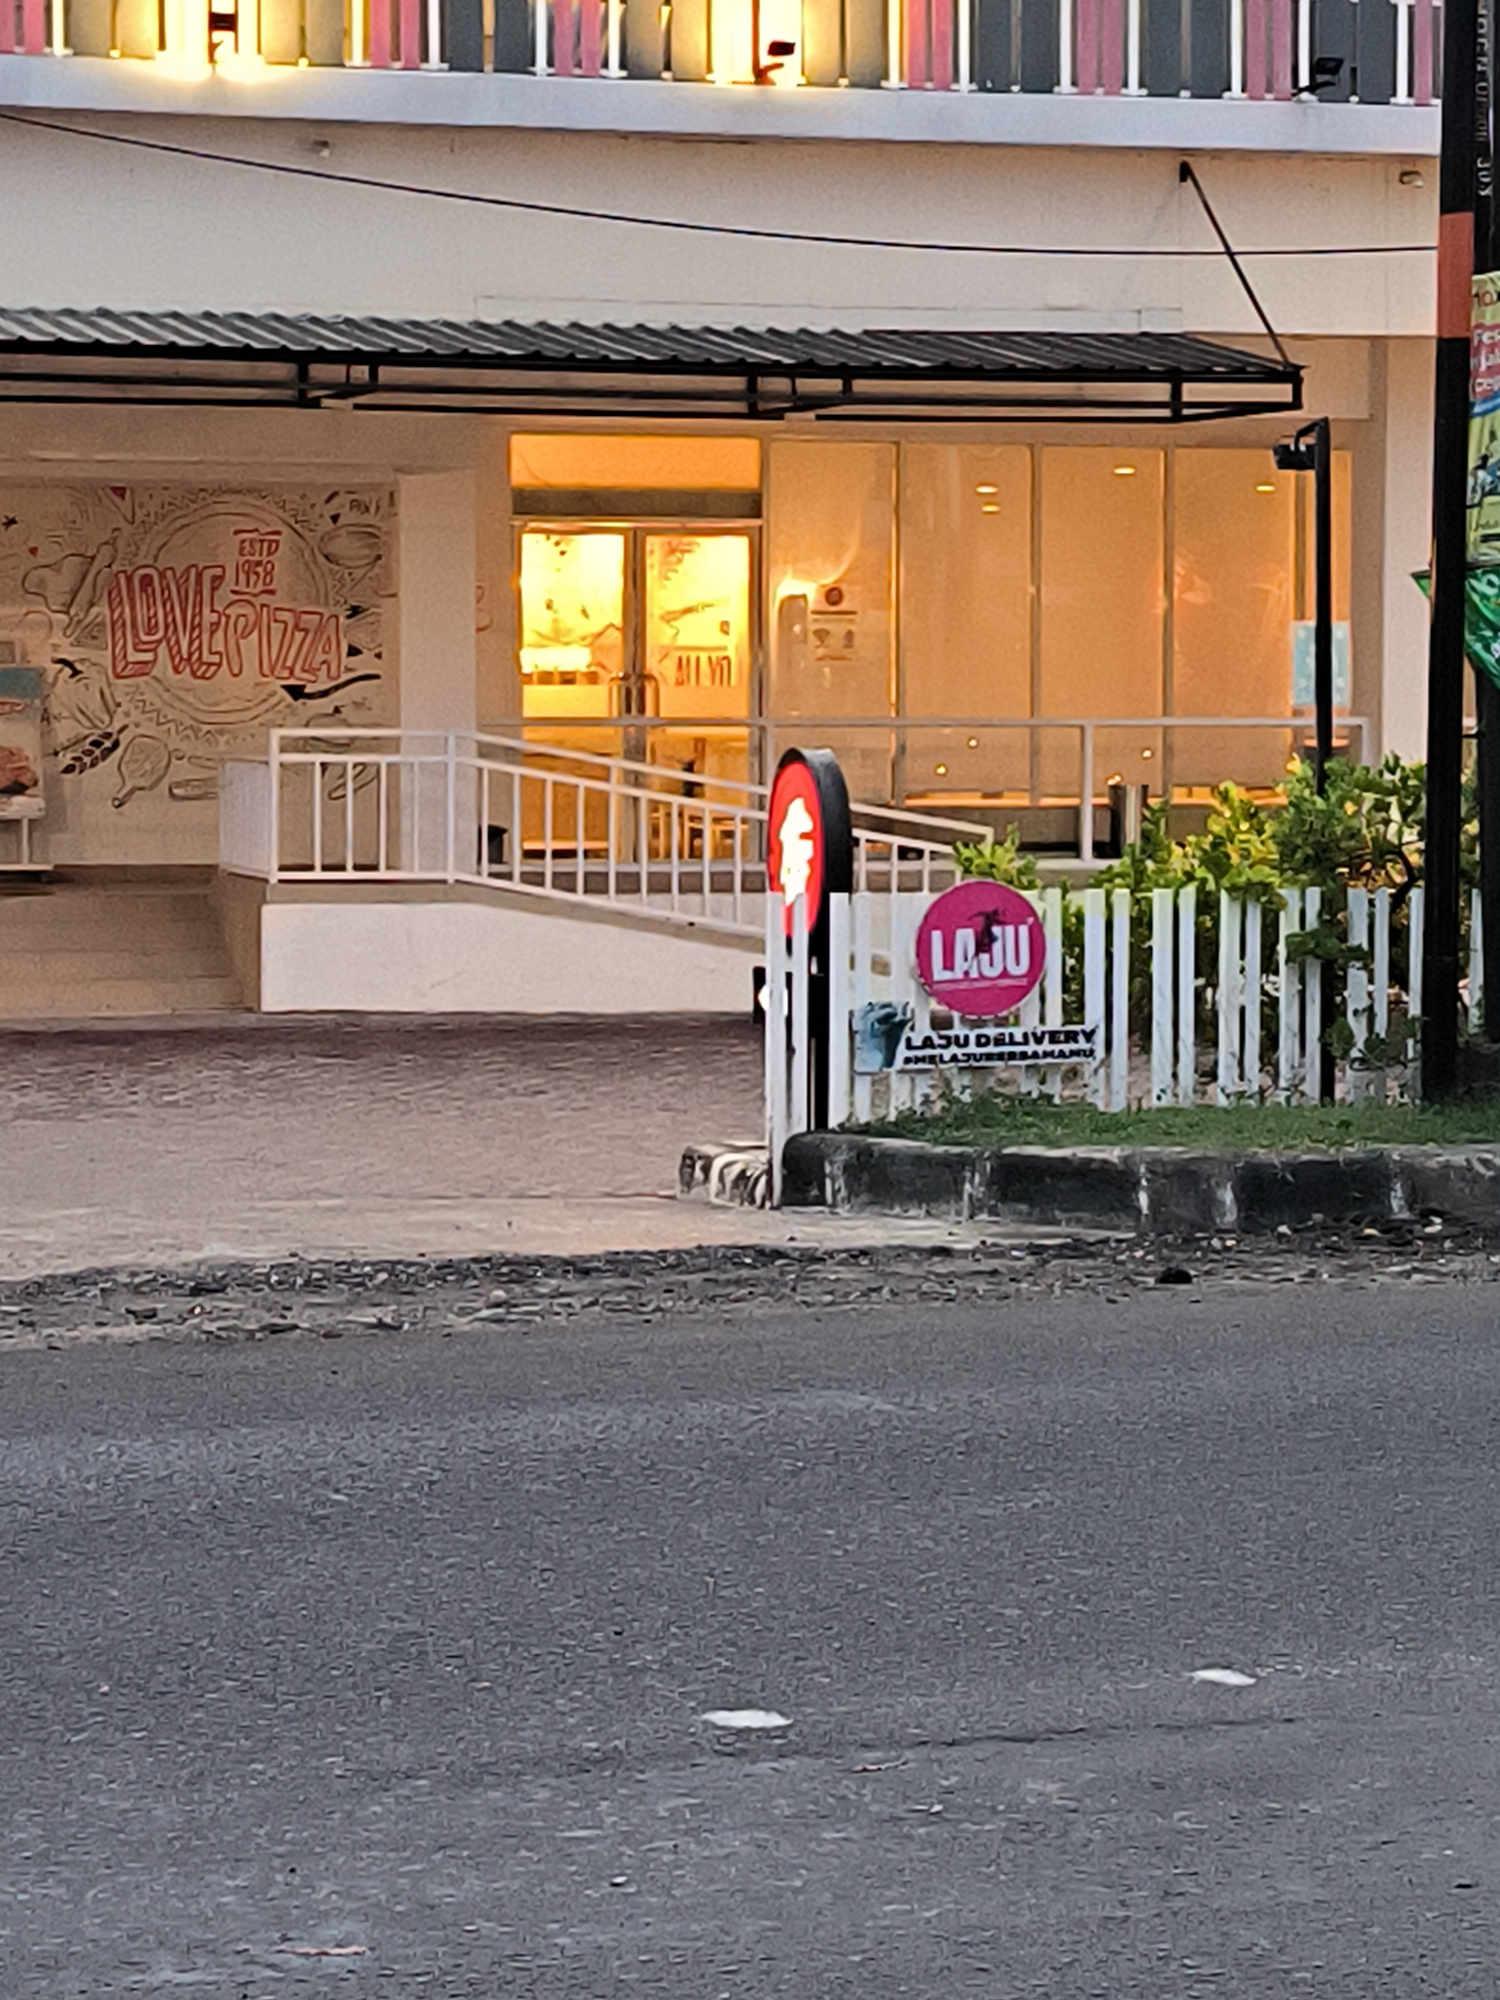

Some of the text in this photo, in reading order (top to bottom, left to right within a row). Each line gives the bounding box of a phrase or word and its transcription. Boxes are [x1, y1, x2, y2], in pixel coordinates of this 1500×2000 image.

[239, 537, 281, 558] ESTD
[235, 559, 276, 589] 1958
[108, 564, 341, 682] LOVE PIZZA
[930, 923, 1031, 981] LAJU
[904, 1029, 1098, 1051] LAJU DELIVERY
